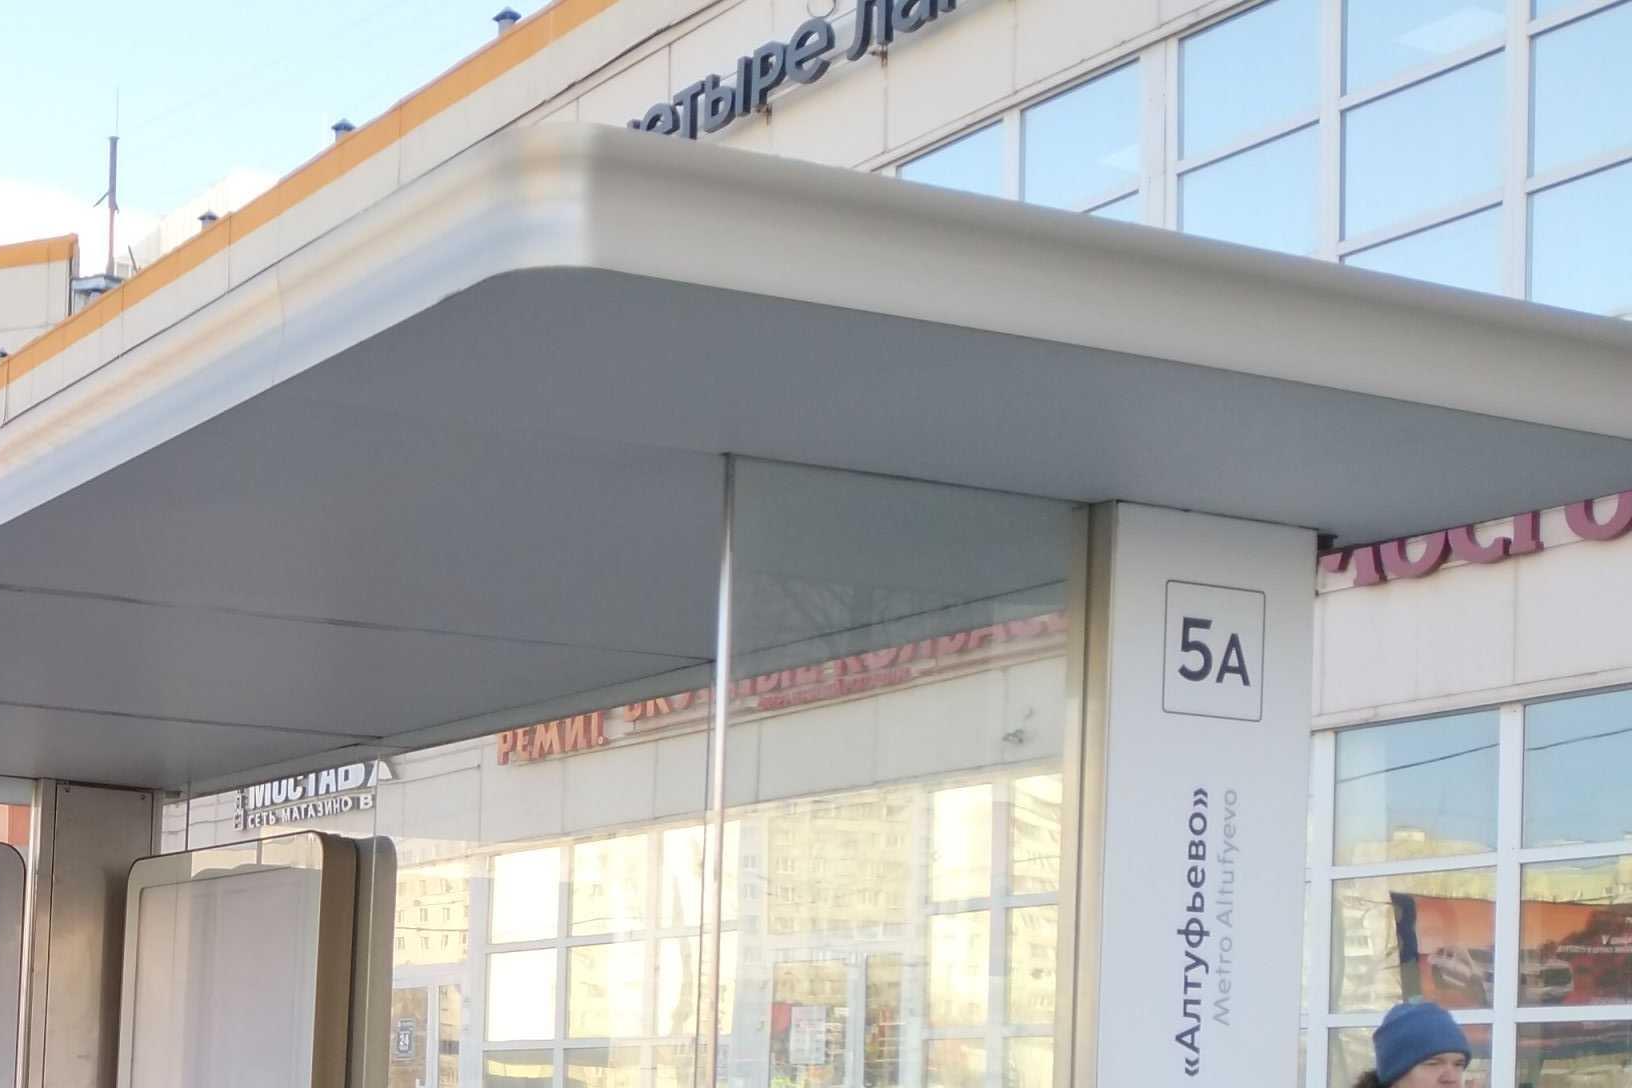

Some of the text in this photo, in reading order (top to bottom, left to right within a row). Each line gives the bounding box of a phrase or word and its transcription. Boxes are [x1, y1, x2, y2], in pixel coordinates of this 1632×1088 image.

[626, 17, 836, 140] етыре
[1174, 787, 1211, 1079] «Алтуфьево»
[1212, 788, 1240, 1027] Metro Altufyevo
